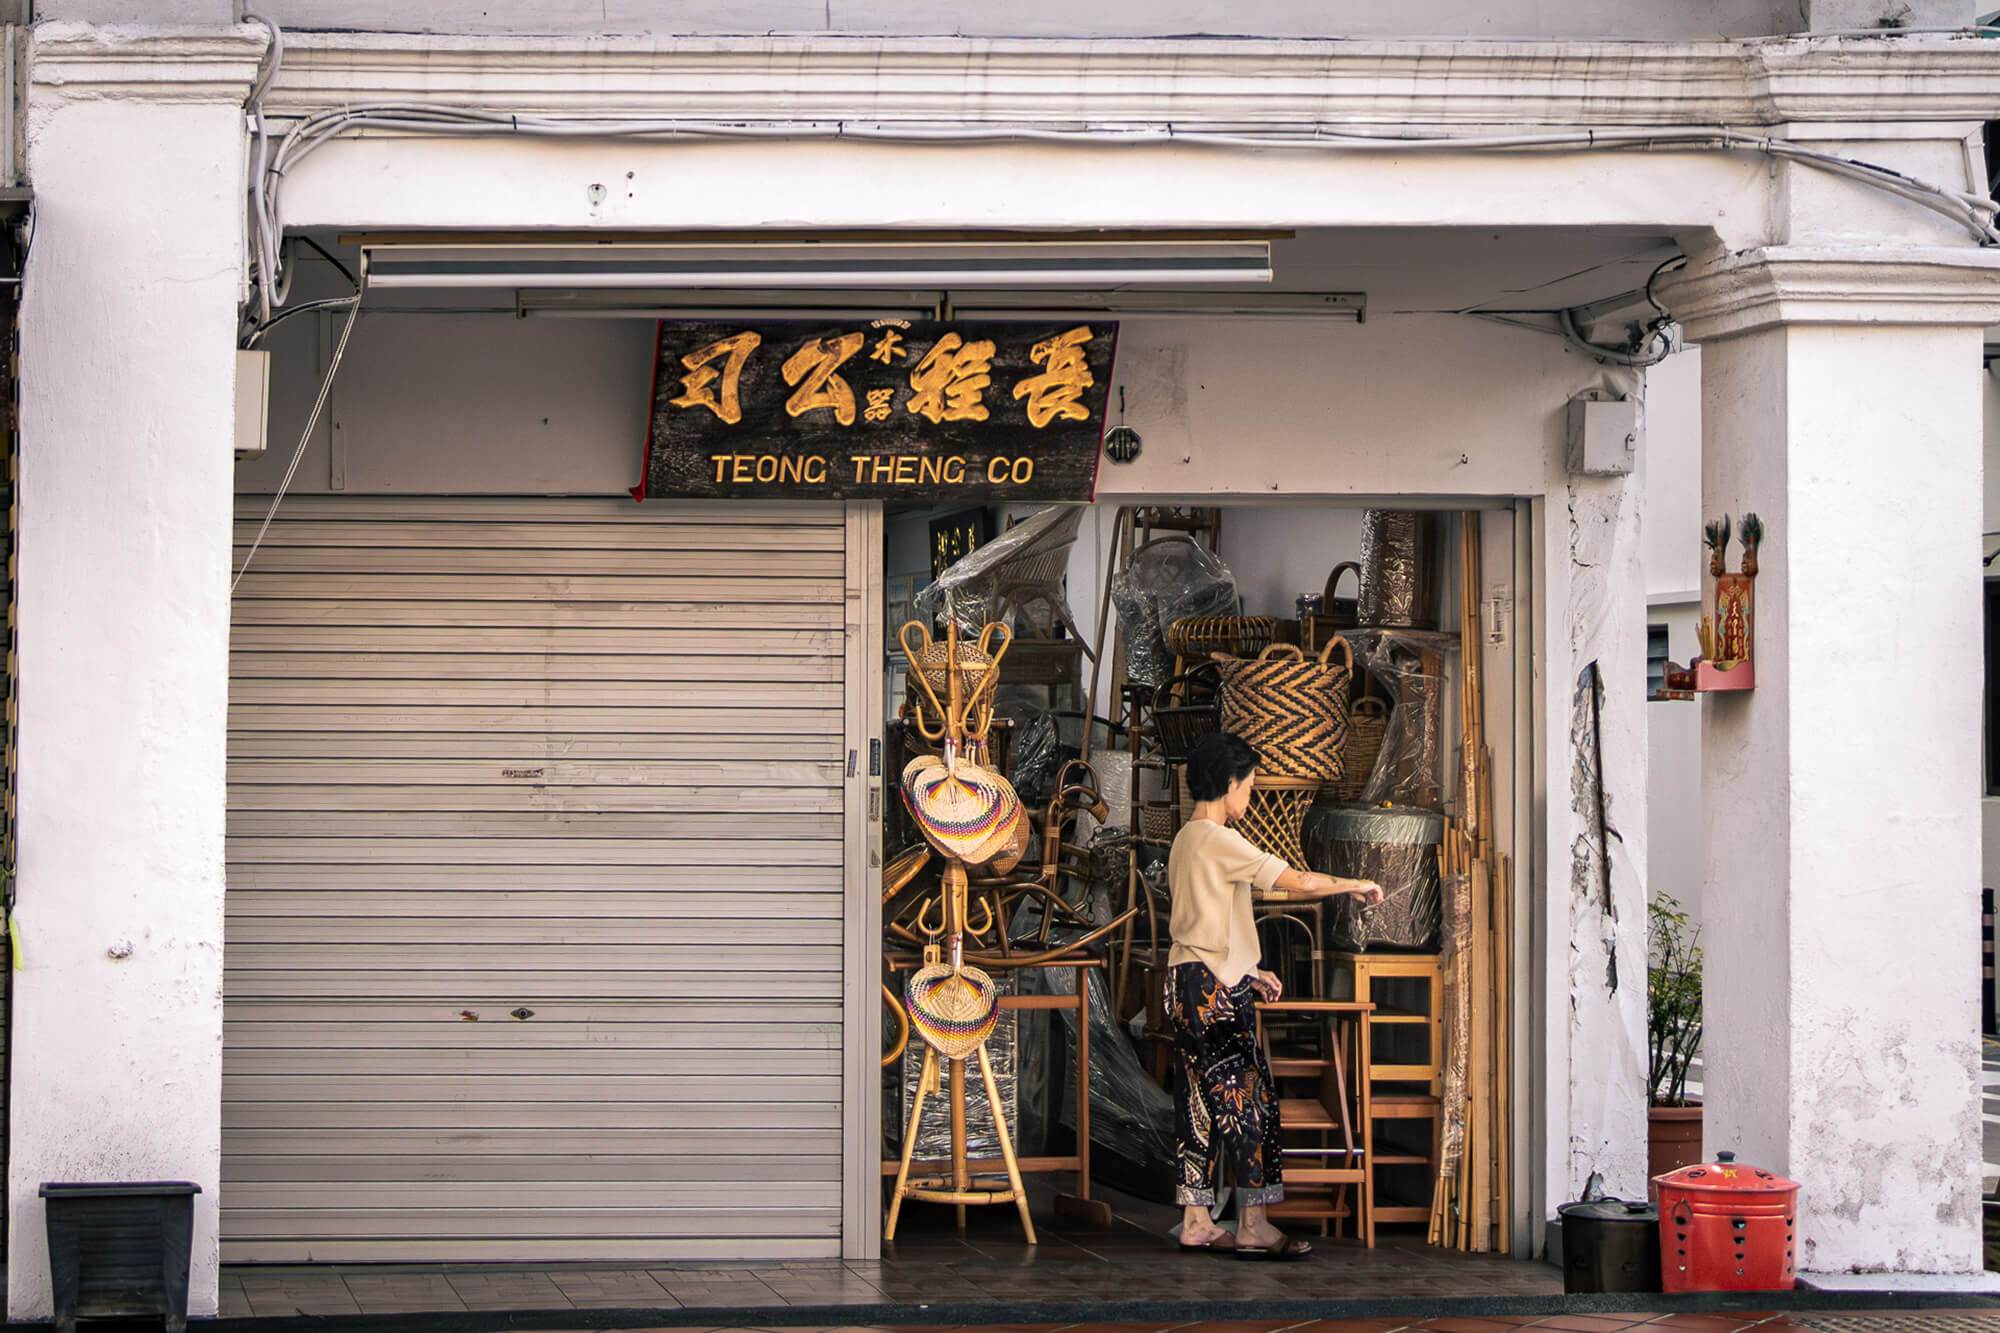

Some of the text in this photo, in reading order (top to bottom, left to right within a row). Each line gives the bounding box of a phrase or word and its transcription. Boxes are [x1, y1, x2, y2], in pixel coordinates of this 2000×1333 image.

[711, 455, 1034, 484] TEONG THENG CO
